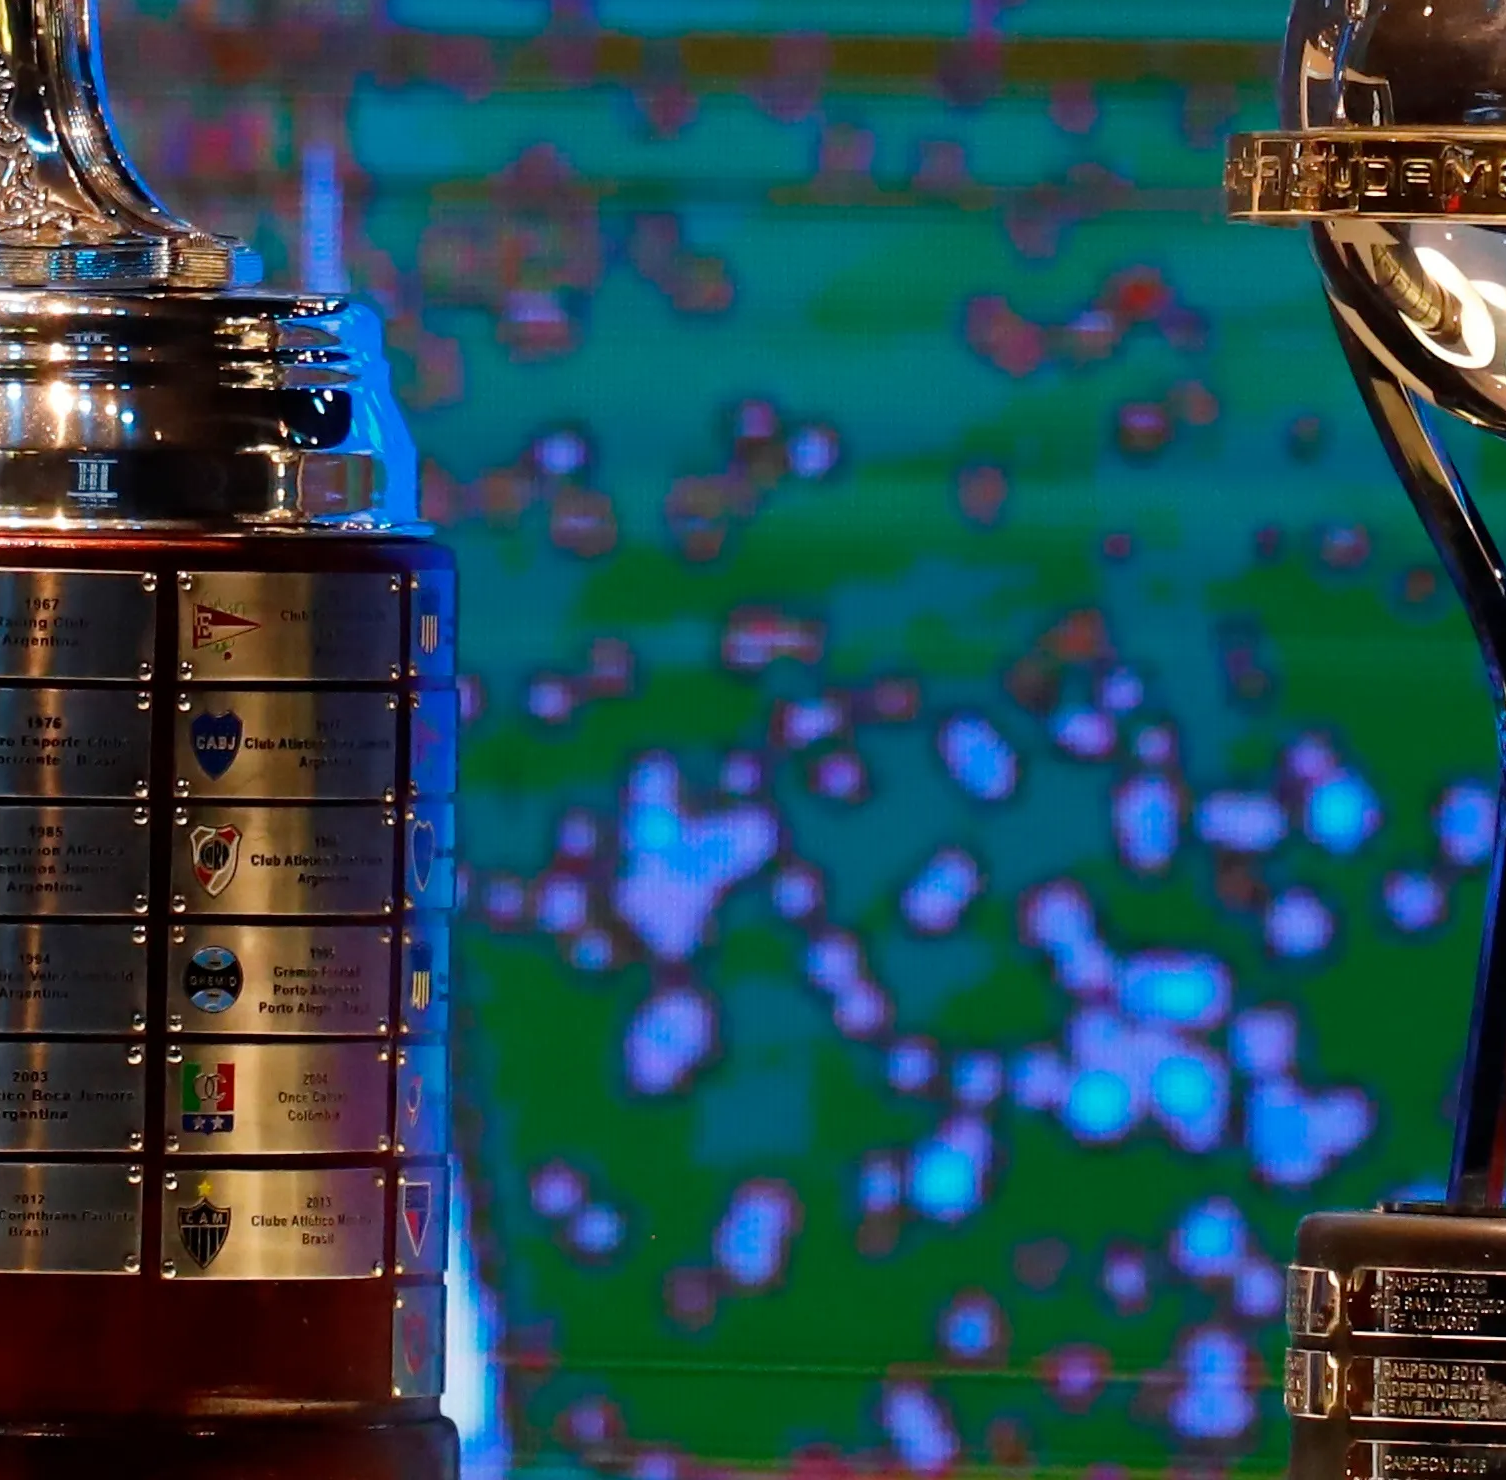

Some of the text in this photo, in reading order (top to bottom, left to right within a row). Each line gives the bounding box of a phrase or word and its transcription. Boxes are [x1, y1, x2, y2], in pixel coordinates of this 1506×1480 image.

[25, 598, 60, 610] 1967
[196, 735, 237, 750] CABJ
[244, 737, 275, 750] Club
[251, 854, 281, 866] Club
[273, 984, 308, 996] Porto
[259, 1002, 293, 1014] Porto
[12, 1071, 49, 1083] 2003
[32, 1089, 71, 1102] Boca
[278, 1091, 308, 1104] Once
[14, 1193, 45, 1204] 2012
[251, 1215, 288, 1227] Clube
[9, 1225, 50, 1237] Brasil
[302, 1232, 335, 1245] Brasil
[1382, 1361, 1487, 1382] CAMPEON 2010
[1377, 1381, 1491, 1401] INDEPENDIENTE
